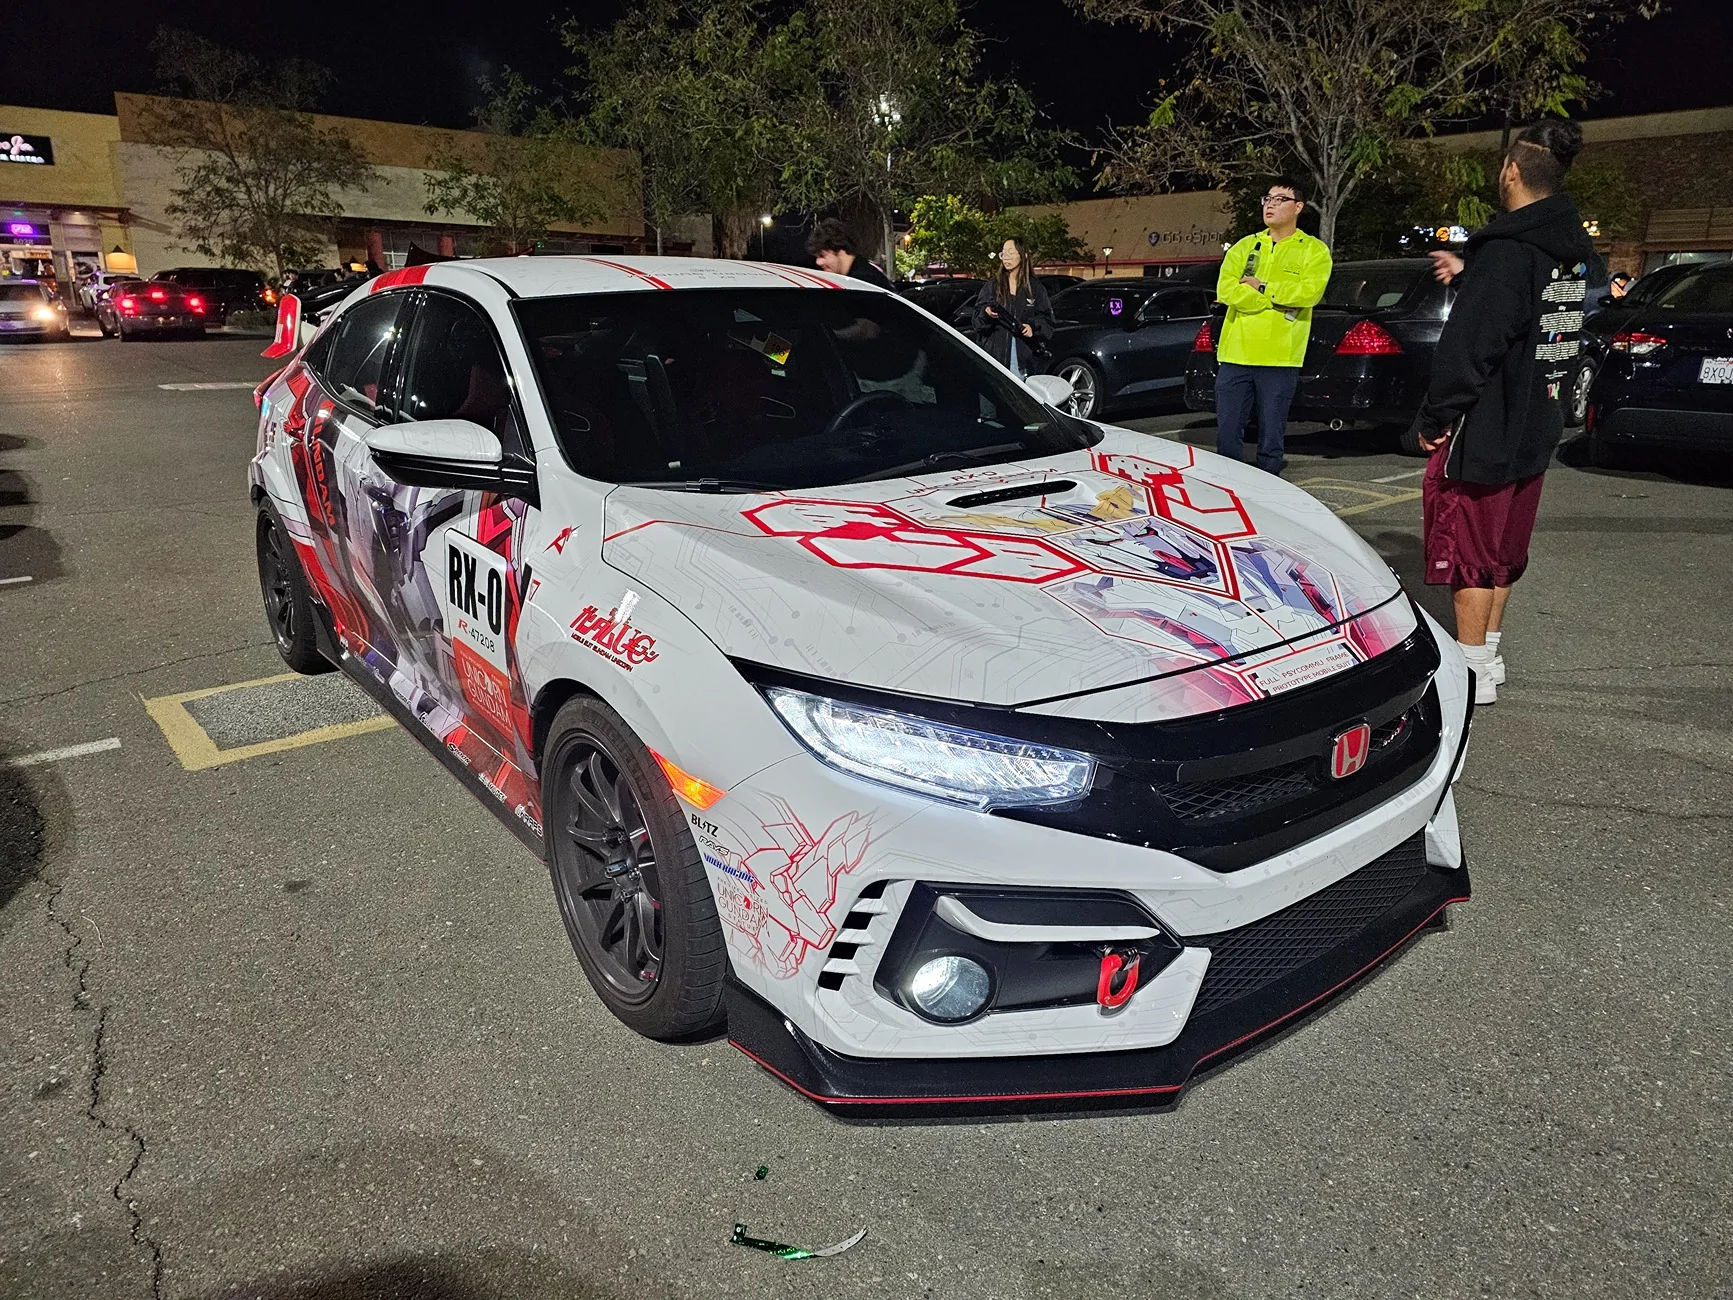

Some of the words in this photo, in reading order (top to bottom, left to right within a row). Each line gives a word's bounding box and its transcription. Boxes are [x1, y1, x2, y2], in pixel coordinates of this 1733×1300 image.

[1162, 231, 1181, 243] GG
[1185, 230, 1224, 245] eSpor
[449, 544, 502, 635] RX-0
[1260, 676, 1280, 687] FULL
[1282, 660, 1325, 678] PSYCOMMU
[1326, 652, 1349, 662] FRAME
[1273, 674, 1313, 692] PROTOTYPE
[1314, 666, 1335, 678] MOBILE
[1336, 660, 1351, 669] SUIT
[691, 813, 718, 837] BLITZ
[699, 835, 730, 856] RAYS
[718, 896, 770, 937] GUNDAM
